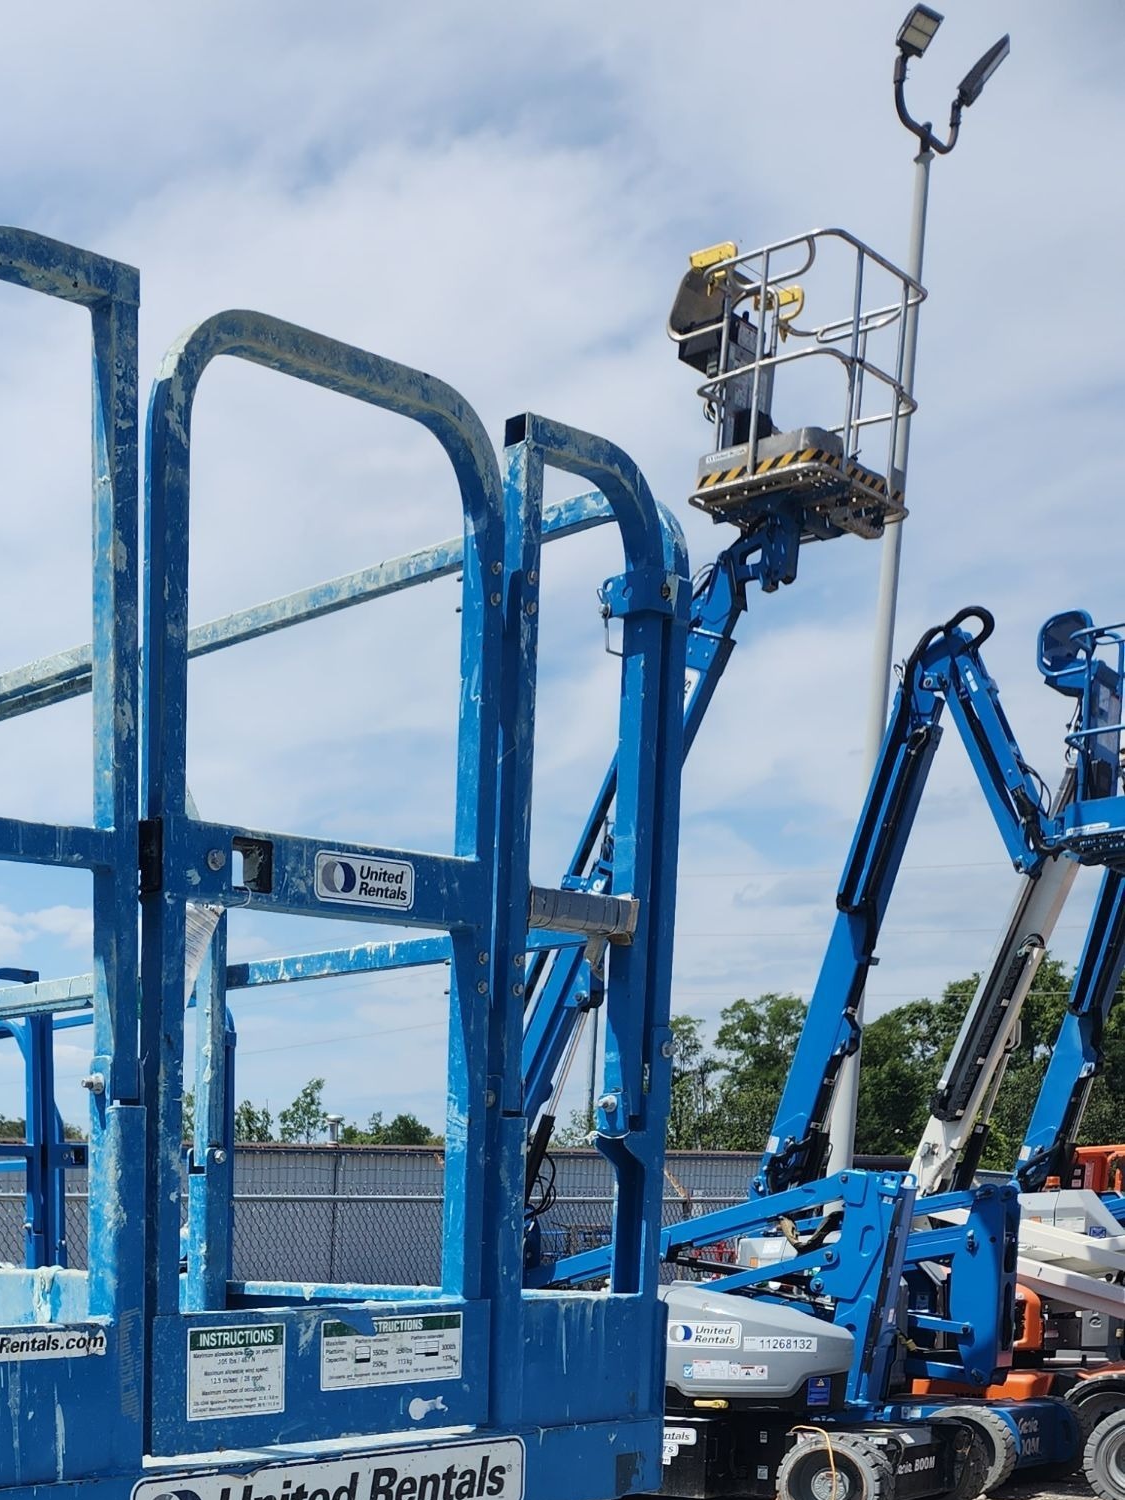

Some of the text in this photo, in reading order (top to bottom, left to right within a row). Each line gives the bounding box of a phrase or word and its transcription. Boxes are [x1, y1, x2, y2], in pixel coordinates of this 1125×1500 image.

[359, 865, 404, 884] United
[359, 882, 407, 900] Rentals
[199, 1329, 274, 1347] INSTRUCTIONS
[695, 1325, 733, 1335] United
[694, 1335, 735, 1344] Rentals
[760, 1338, 813, 1350] 11268132
[897, 1456, 936, 1475] enie BOOM
